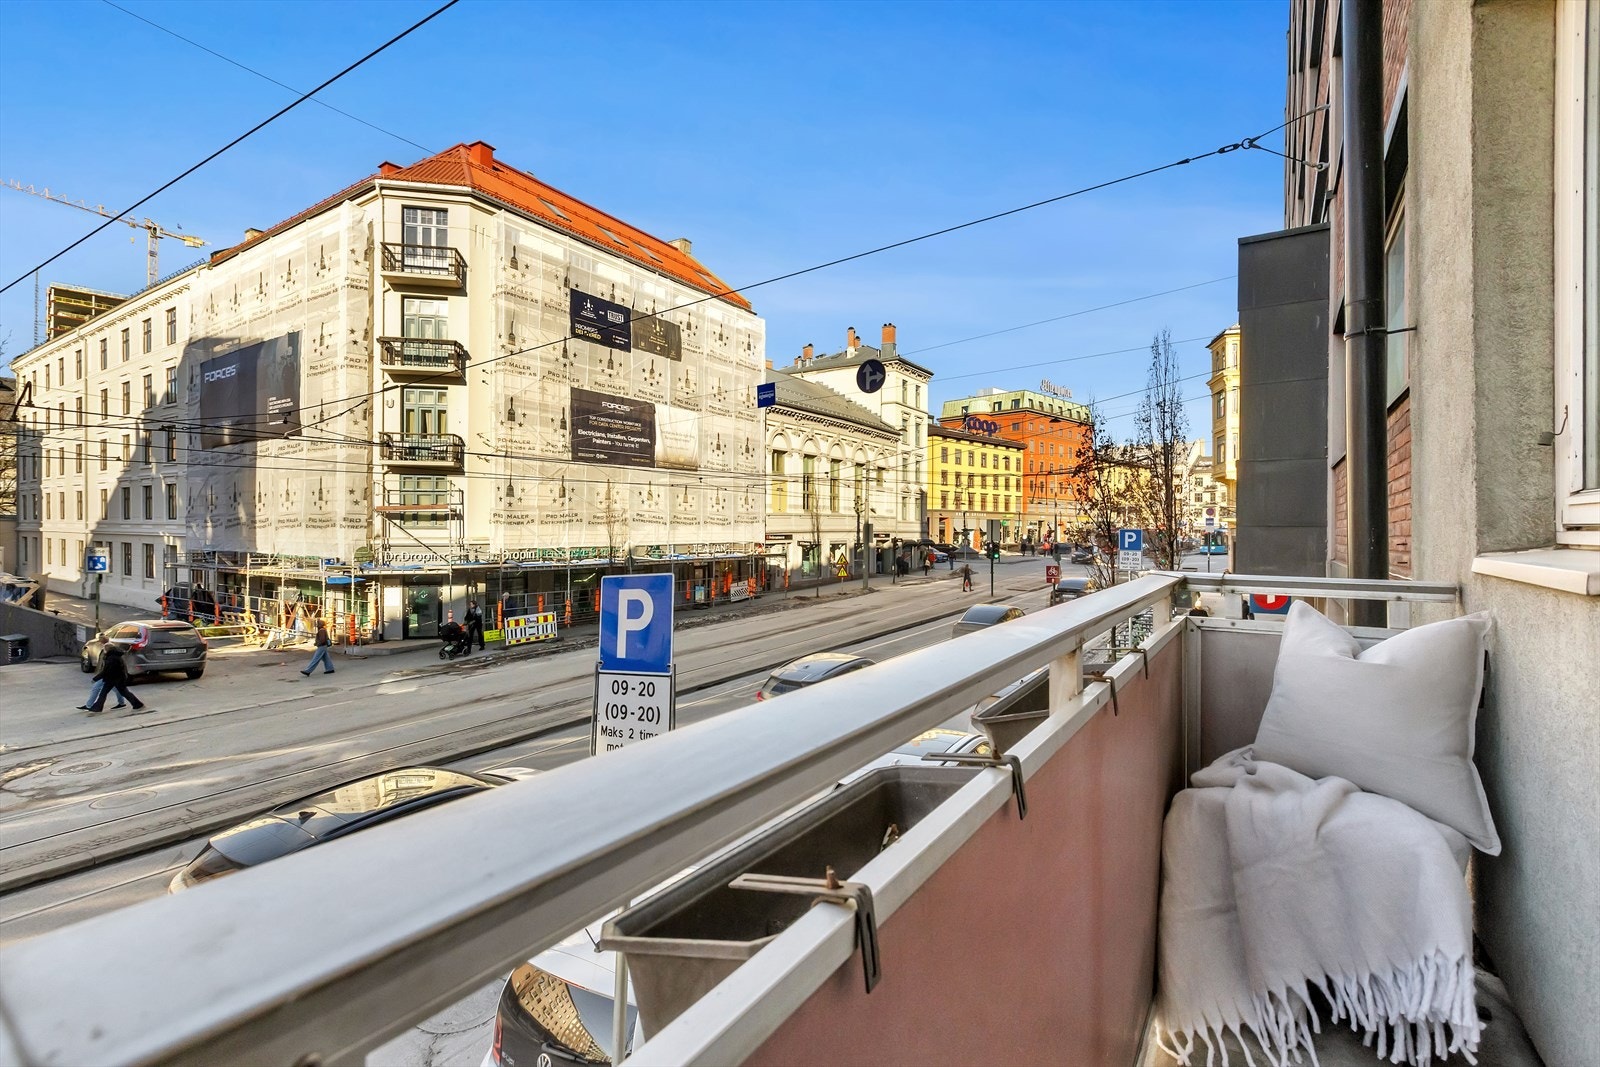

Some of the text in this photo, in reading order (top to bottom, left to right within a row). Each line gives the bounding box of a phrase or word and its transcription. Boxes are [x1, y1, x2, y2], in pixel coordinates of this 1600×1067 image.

[204, 364, 237, 383] FORCES
[602, 401, 630, 412] FORCES
[966, 416, 998, 437] coop
[577, 428, 607, 438] Electricians,
[607, 432, 627, 441] Installers,
[627, 435, 651, 444] Carpenters,
[592, 437, 611, 445] Painters
[1124, 531, 1137, 548] P
[616, 588, 654, 659] P
[600, 725, 624, 738] Maks
[628, 728, 634, 739] 2
